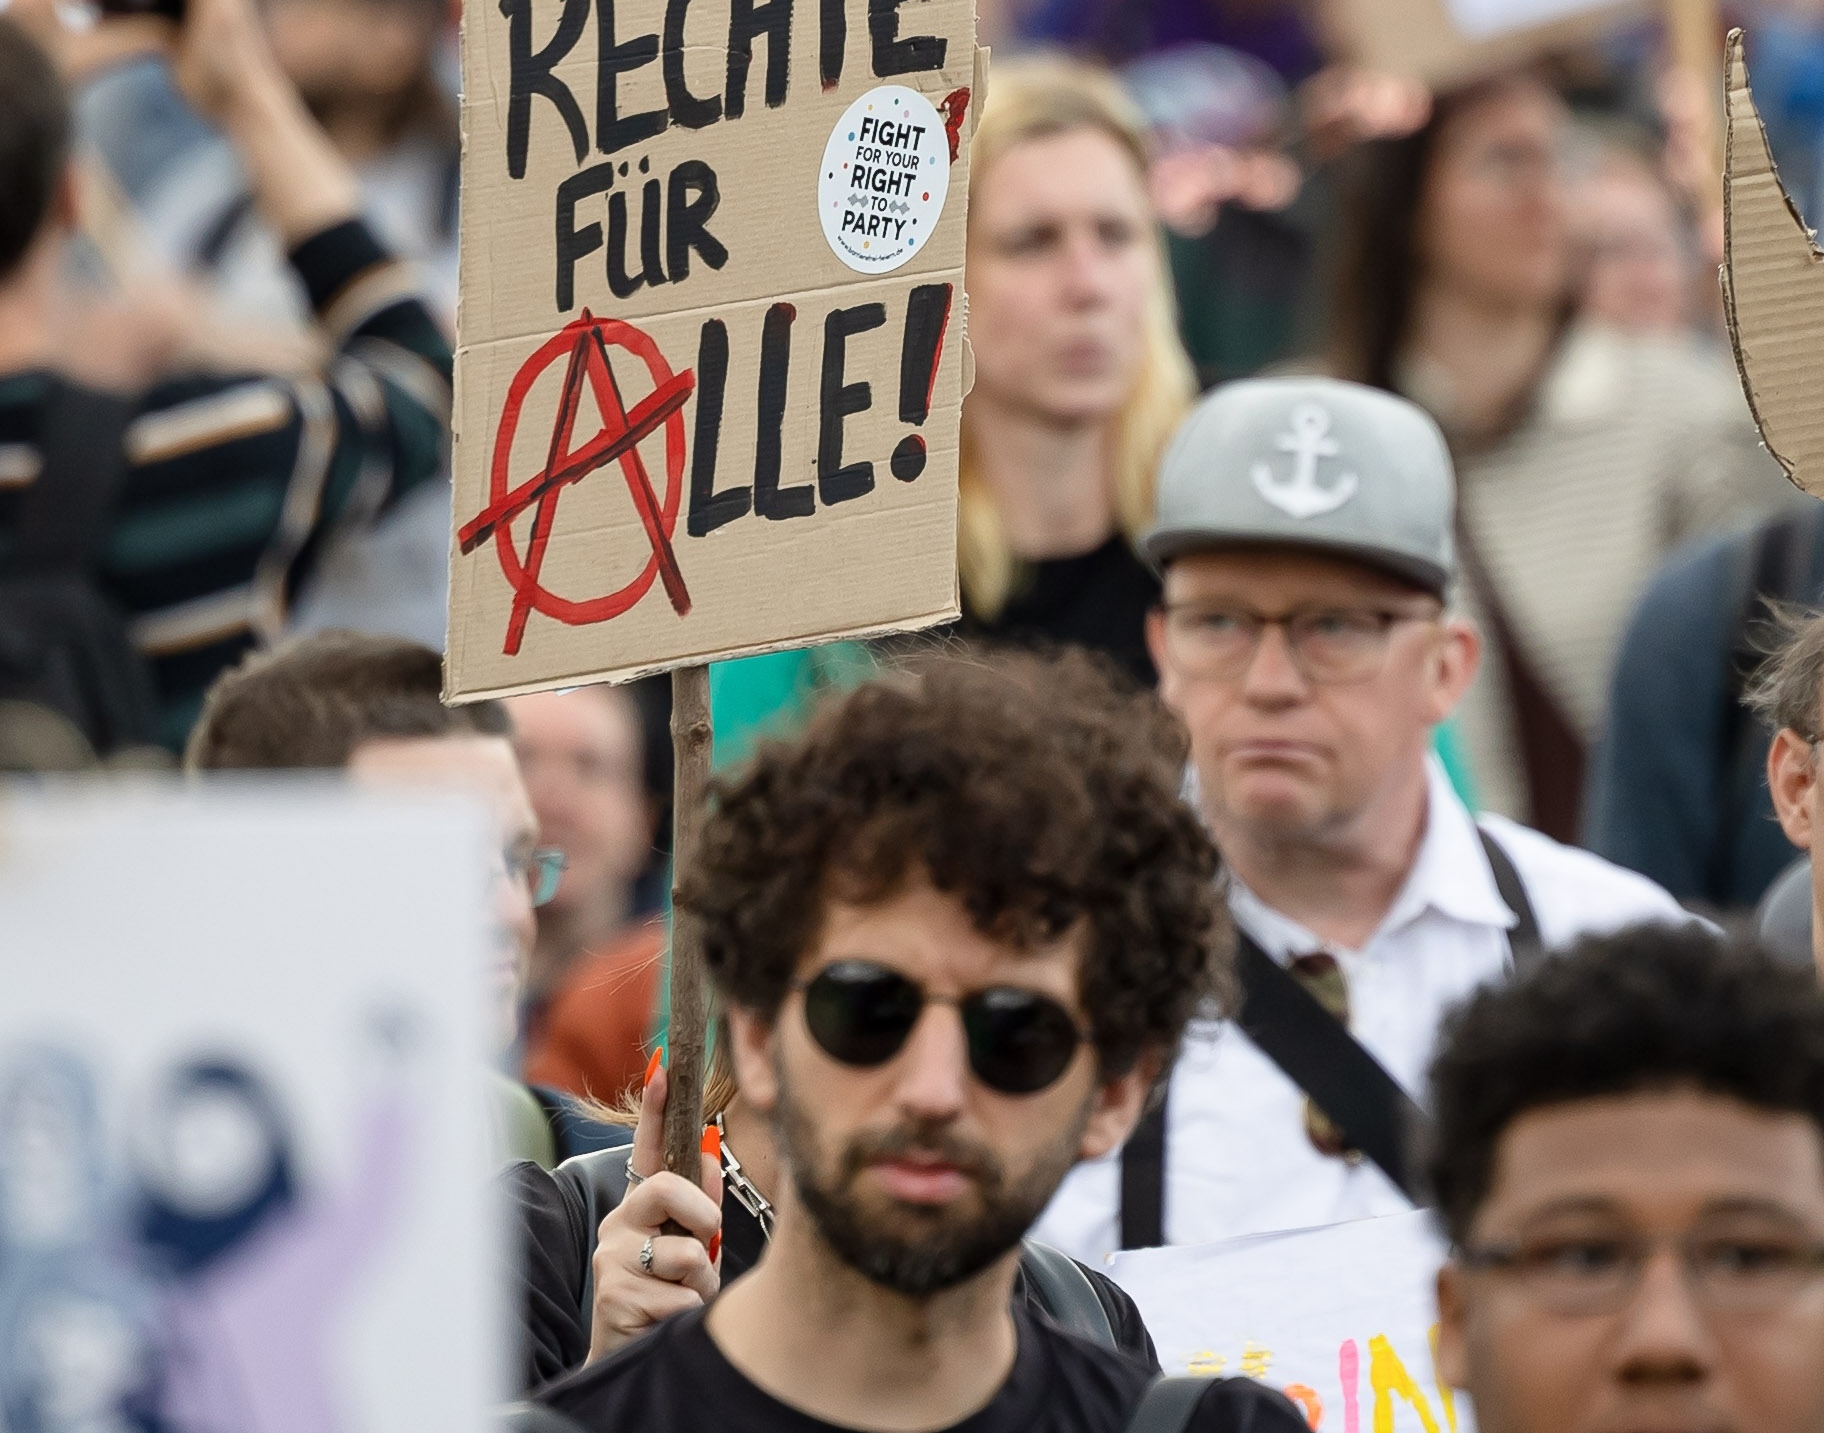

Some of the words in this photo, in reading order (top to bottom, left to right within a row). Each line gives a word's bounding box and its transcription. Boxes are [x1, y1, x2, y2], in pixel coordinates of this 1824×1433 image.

[859, 117, 926, 151] FIGHT
[855, 145, 882, 164] FOR
[886, 150, 920, 170] YOUR
[850, 164, 917, 197] RIGHT
[871, 196, 888, 212] TO
[555, 155, 729, 313] FÜR
[841, 210, 907, 241] PARTY
[457, 282, 953, 656] ALLE!
